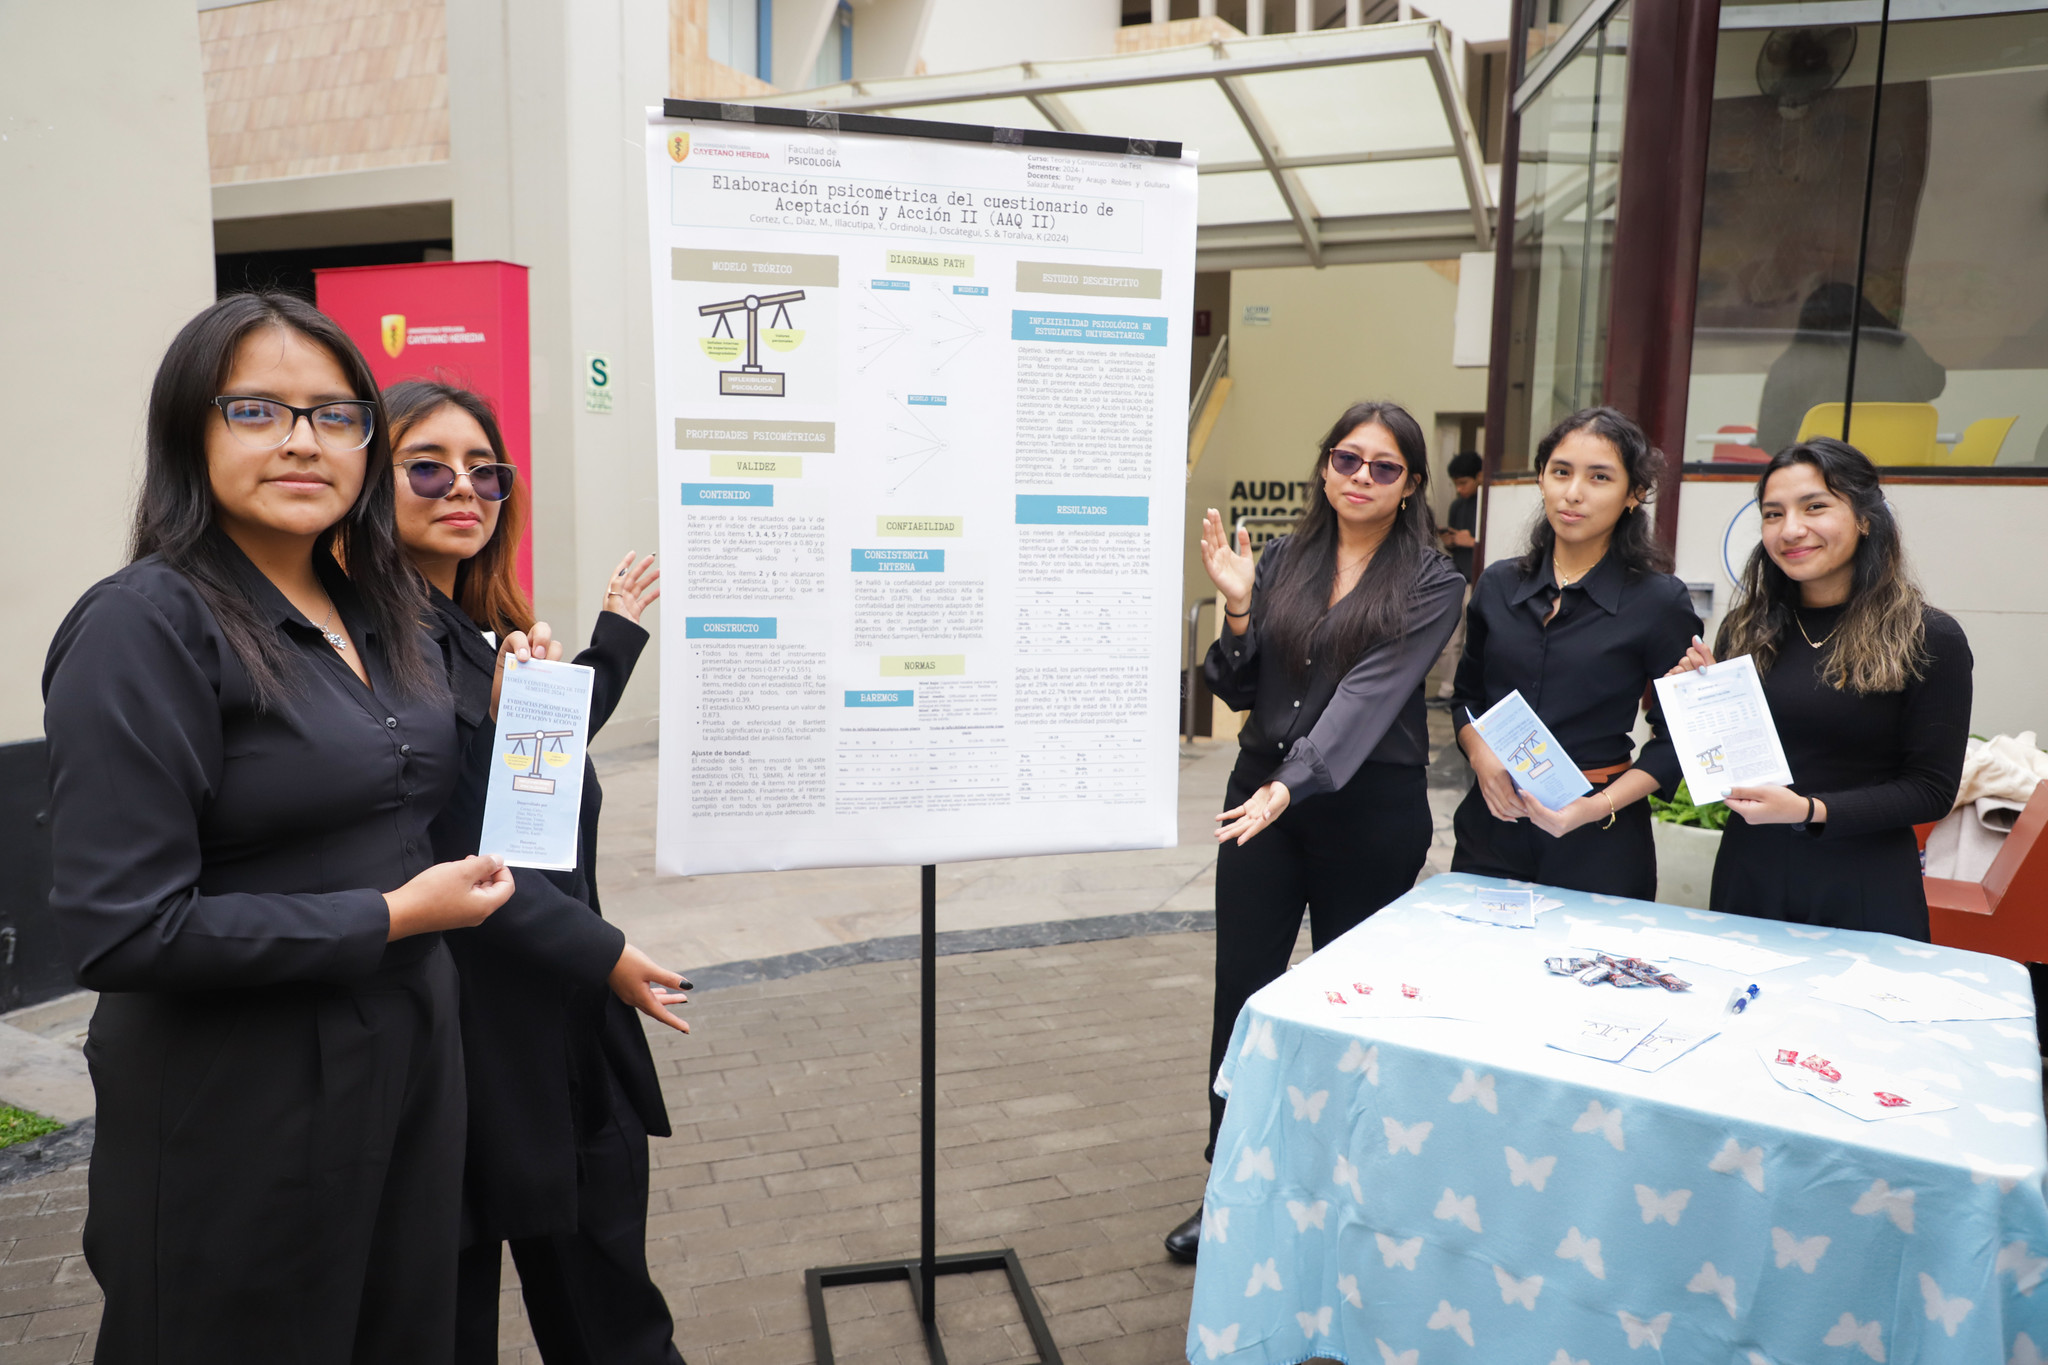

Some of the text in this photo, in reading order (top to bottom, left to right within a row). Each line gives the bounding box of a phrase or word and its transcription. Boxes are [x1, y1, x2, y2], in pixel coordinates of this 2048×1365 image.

[693, 148, 734, 157] CAYETANO
[788, 144, 837, 156] Facultad de
[789, 156, 841, 168] PSICOLOGÍA
[1078, 158, 1118, 168] Construcción
[1027, 172, 1061, 183] Docentes:
[1066, 175, 1082, 184] Dany
[1144, 181, 1170, 189] Giuliana
[1051, 182, 1074, 190] Álvarez
[712, 175, 1114, 216] Elaboración psicométrica del cuestionario de
[775, 197, 1055, 230] Aceptación y Acción II (AAQ II)
[749, 214, 780, 225] Cortez,
[783, 216, 794, 225] C.,
[820, 218, 833, 228] M.,
[835, 219, 876, 232] Illacutipa,
[890, 223, 928, 234] Ordinola,
[939, 226, 982, 238] Oscátegui,
[1003, 230, 1034, 241] Toralva,
[1044, 233, 1069, 244] (2024)
[891, 254, 965, 268] DIAGRAMAS PATH
[712, 261, 792, 274] MODELO TEÓRICO
[1042, 274, 1139, 287] ESTUDIO DESCRIPTIVO
[1029, 316, 1152, 330] INFLEXIBILIDAD PSICOLÓGICA EN
[1035, 328, 1145, 340] ESTUDIANTES UNIVERSITARIOS
[592, 358, 607, 386] S
[686, 429, 826, 442] PROPIEDADES PSICOMÉTRICAS
[737, 462, 776, 471] VALIDEZ
[700, 490, 751, 500] CONTENIDO
[1230, 482, 1313, 500] AUDIT
[1057, 505, 1108, 515] RESULTADOS
[887, 522, 955, 531] CONFIABILIDAD
[865, 551, 929, 560] CONSISTENCIA
[878, 562, 916, 571] INTERNA
[703, 623, 760, 633] CONSTRUCTO
[905, 662, 936, 670] NORMAS
[861, 693, 898, 702] BAREMOS
